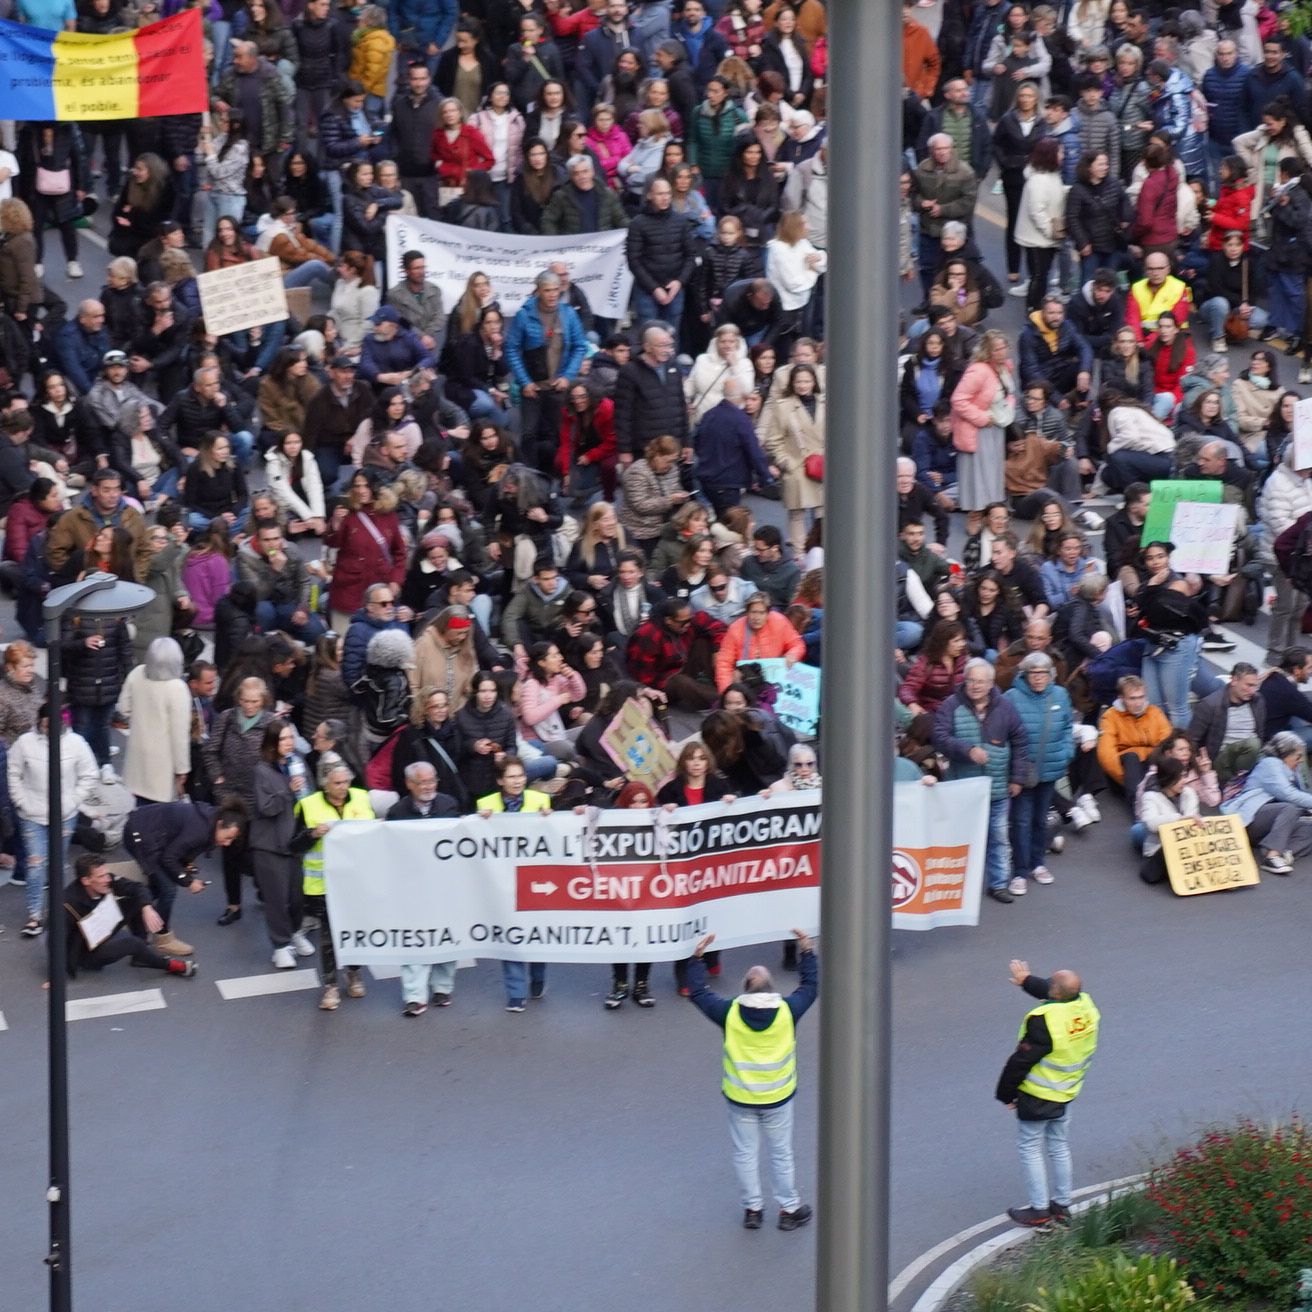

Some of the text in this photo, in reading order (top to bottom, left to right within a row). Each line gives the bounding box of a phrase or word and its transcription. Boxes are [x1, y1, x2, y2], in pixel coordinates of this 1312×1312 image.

[434, 836, 551, 860] CONTRA
[567, 855, 813, 900] GENT ORGANITZADA
[340, 916, 709, 949] PROTESTA, ORGANITZA'T, LLUITA!
